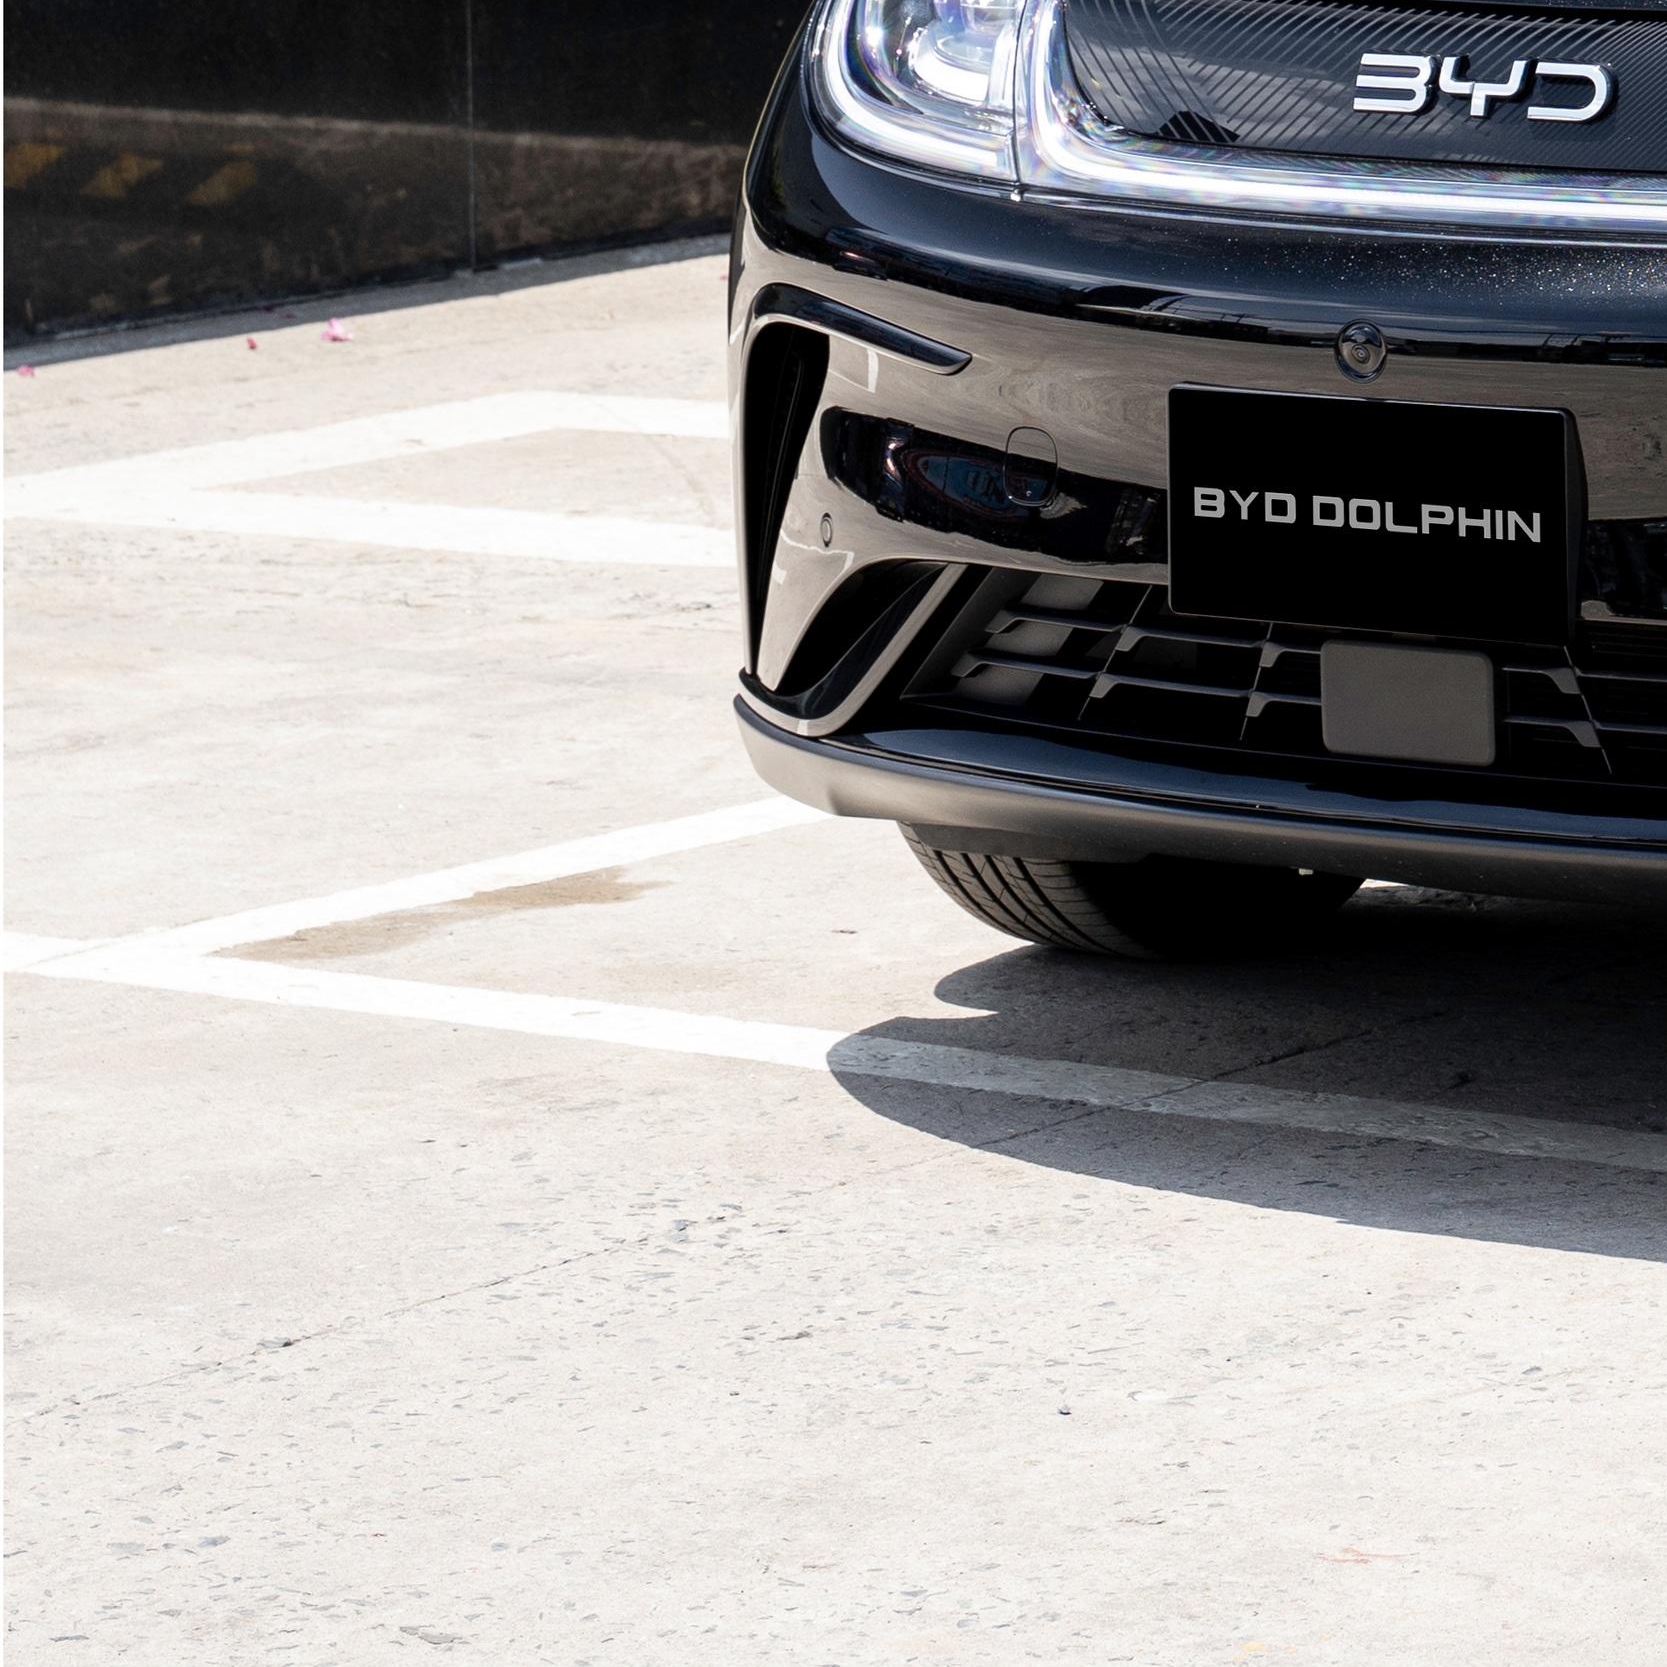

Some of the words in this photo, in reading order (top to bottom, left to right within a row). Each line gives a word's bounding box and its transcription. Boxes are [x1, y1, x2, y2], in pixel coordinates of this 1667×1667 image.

[1352, 52, 1613, 122] BYD
[1193, 487, 1297, 524] BYD
[1311, 496, 1542, 543] DOLPHIN
